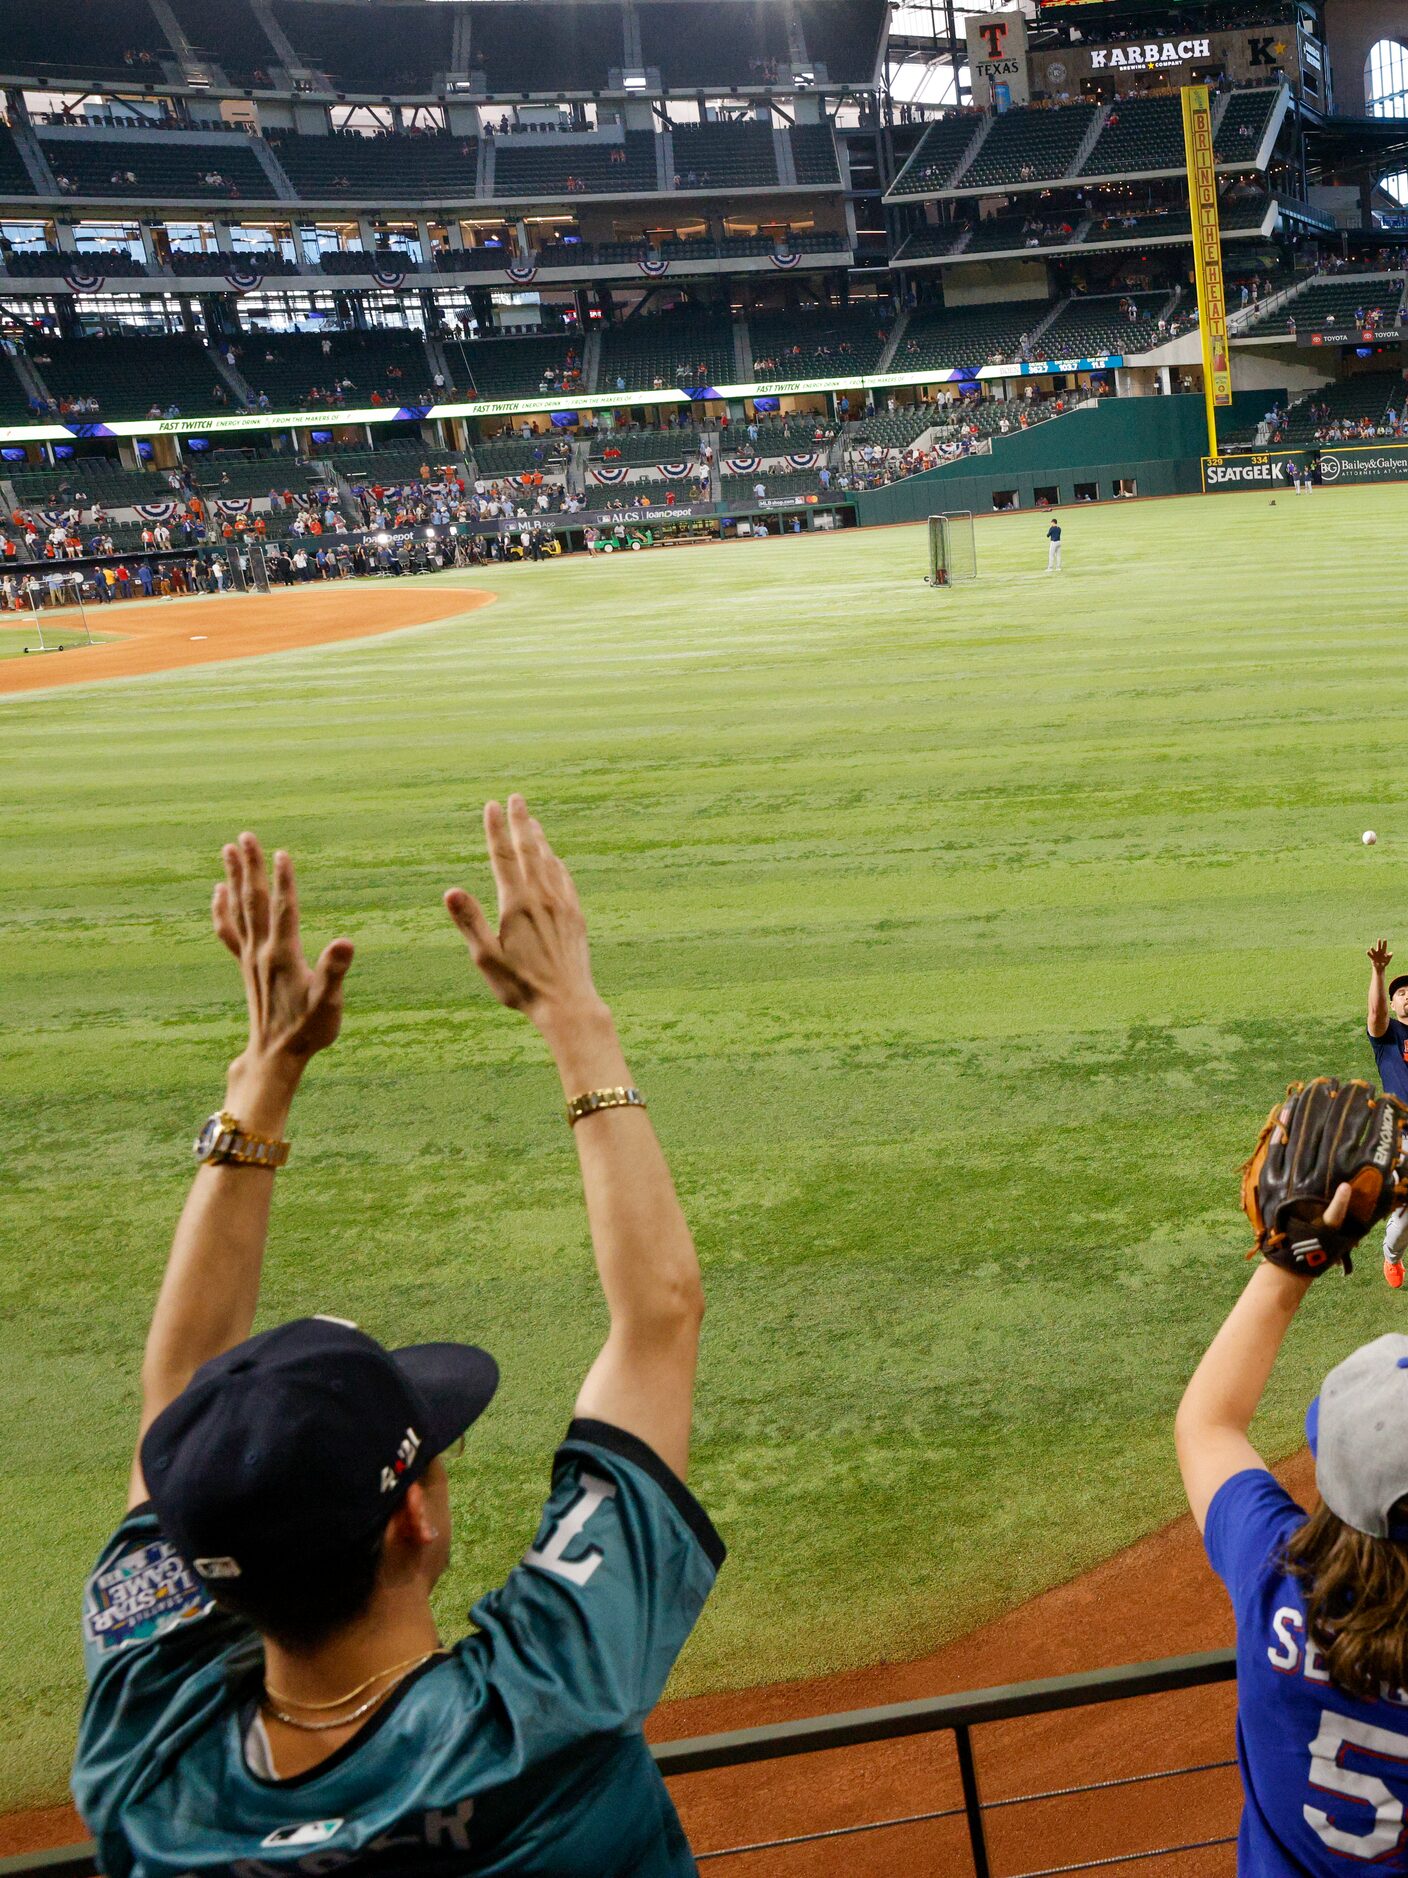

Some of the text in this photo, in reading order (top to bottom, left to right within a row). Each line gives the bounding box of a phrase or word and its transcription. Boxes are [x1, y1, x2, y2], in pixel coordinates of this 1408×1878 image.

[979, 22, 1009, 59] T
[1090, 38, 1210, 69] KARBACH
[1248, 37, 1276, 66] K
[976, 61, 1019, 77] TEXAS
[1119, 60, 1184, 72] BREWING COMPANY
[1209, 266, 1220, 335] HEAT
[1324, 334, 1348, 342] TOYOTA
[1375, 330, 1399, 338] TOYOTA
[774, 383, 800, 392] TWITCH
[473, 405, 490, 413] FAST
[491, 403, 519, 411] TWITCH
[159, 422, 179, 431] FAST
[180, 420, 213, 430] TWITCH
[216, 419, 240, 427] ENERGY
[1207, 458, 1223, 466] 329
[1251, 456, 1268, 464] 334
[1342, 458, 1408, 470] Bailey&Galyen
[1207, 461, 1284, 484] SEATGEEK
[612, 512, 638, 522] ALCS
[646, 508, 692, 520] loanDepot
[518, 520, 540, 530] MLB
[1373, 1104, 1394, 1166] NOKONA
[109, 1556, 184, 1606] GAME
